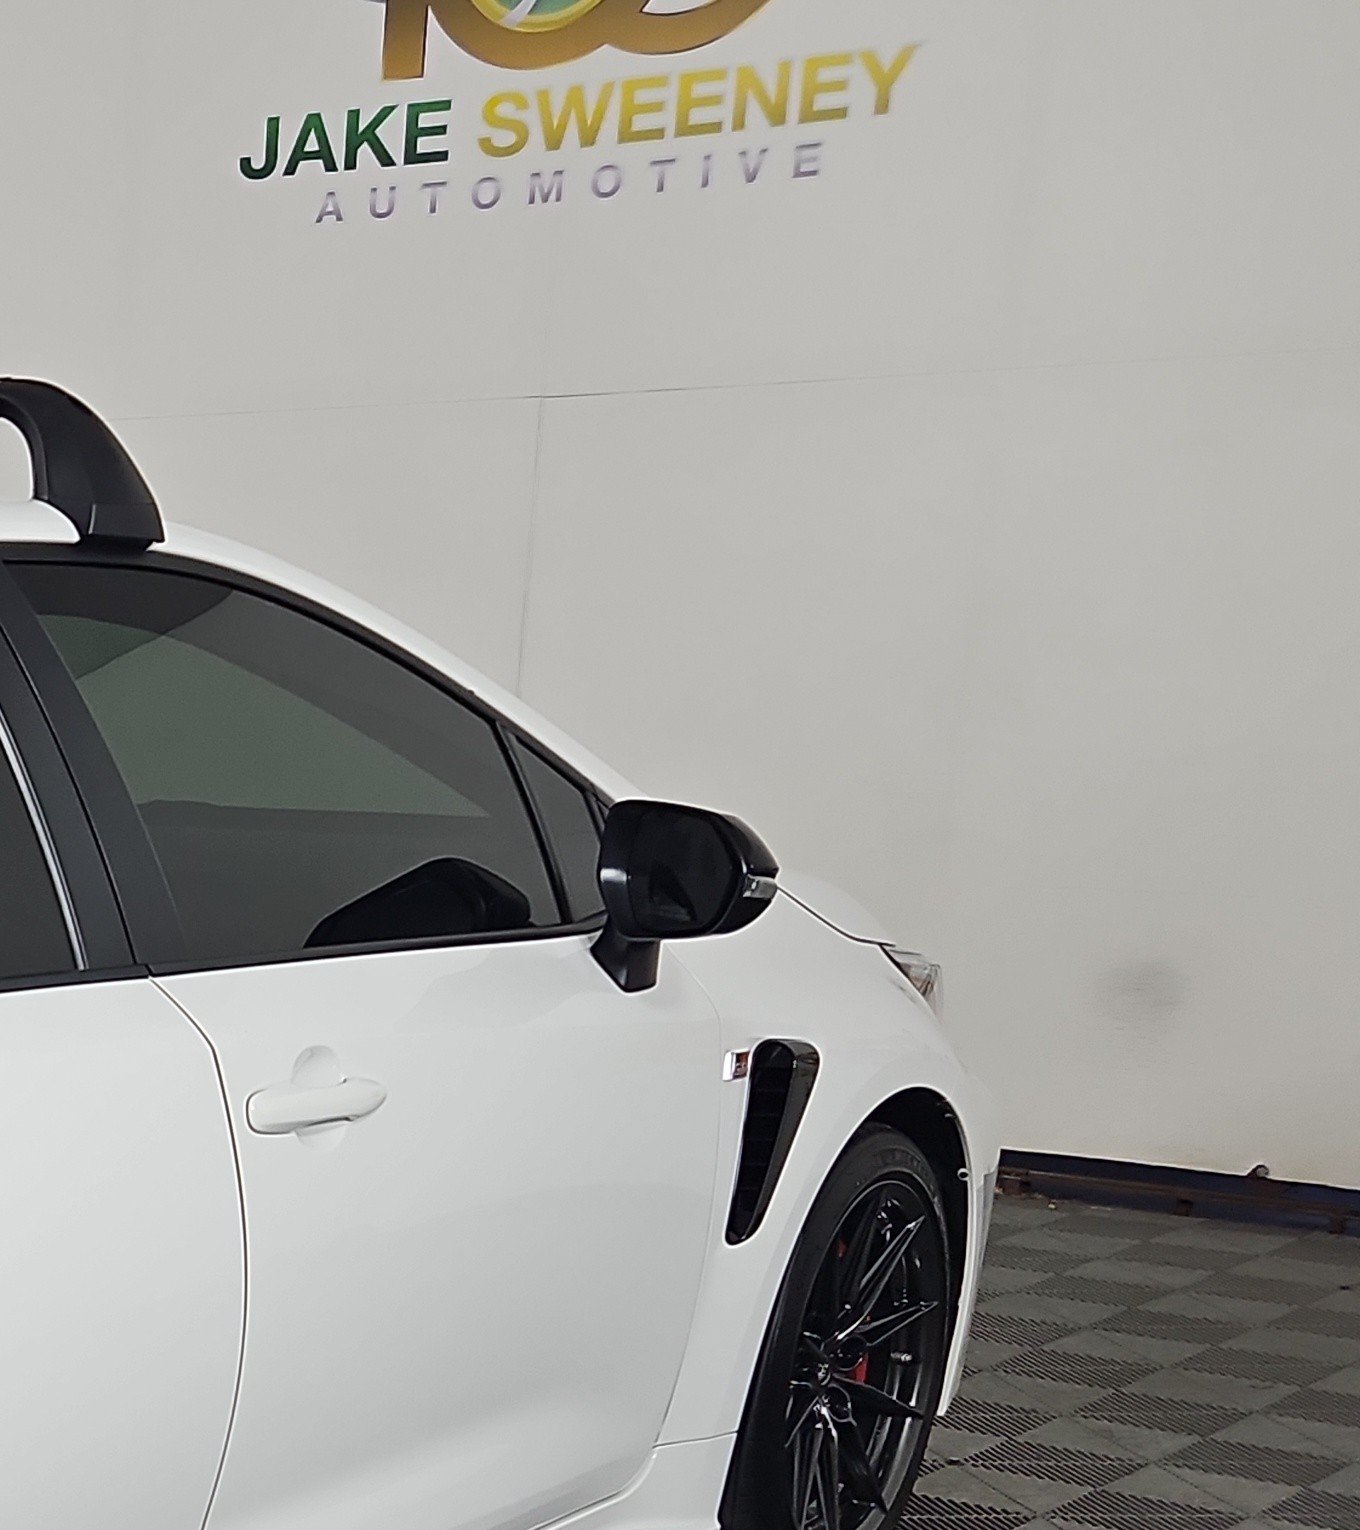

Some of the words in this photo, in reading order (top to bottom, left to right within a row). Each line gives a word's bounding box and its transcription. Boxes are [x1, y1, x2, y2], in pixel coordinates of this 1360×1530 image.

[238, 98, 453, 181] JAKE
[477, 43, 920, 158] SWEENEY
[315, 142, 823, 224] AUTOMOTIVE
